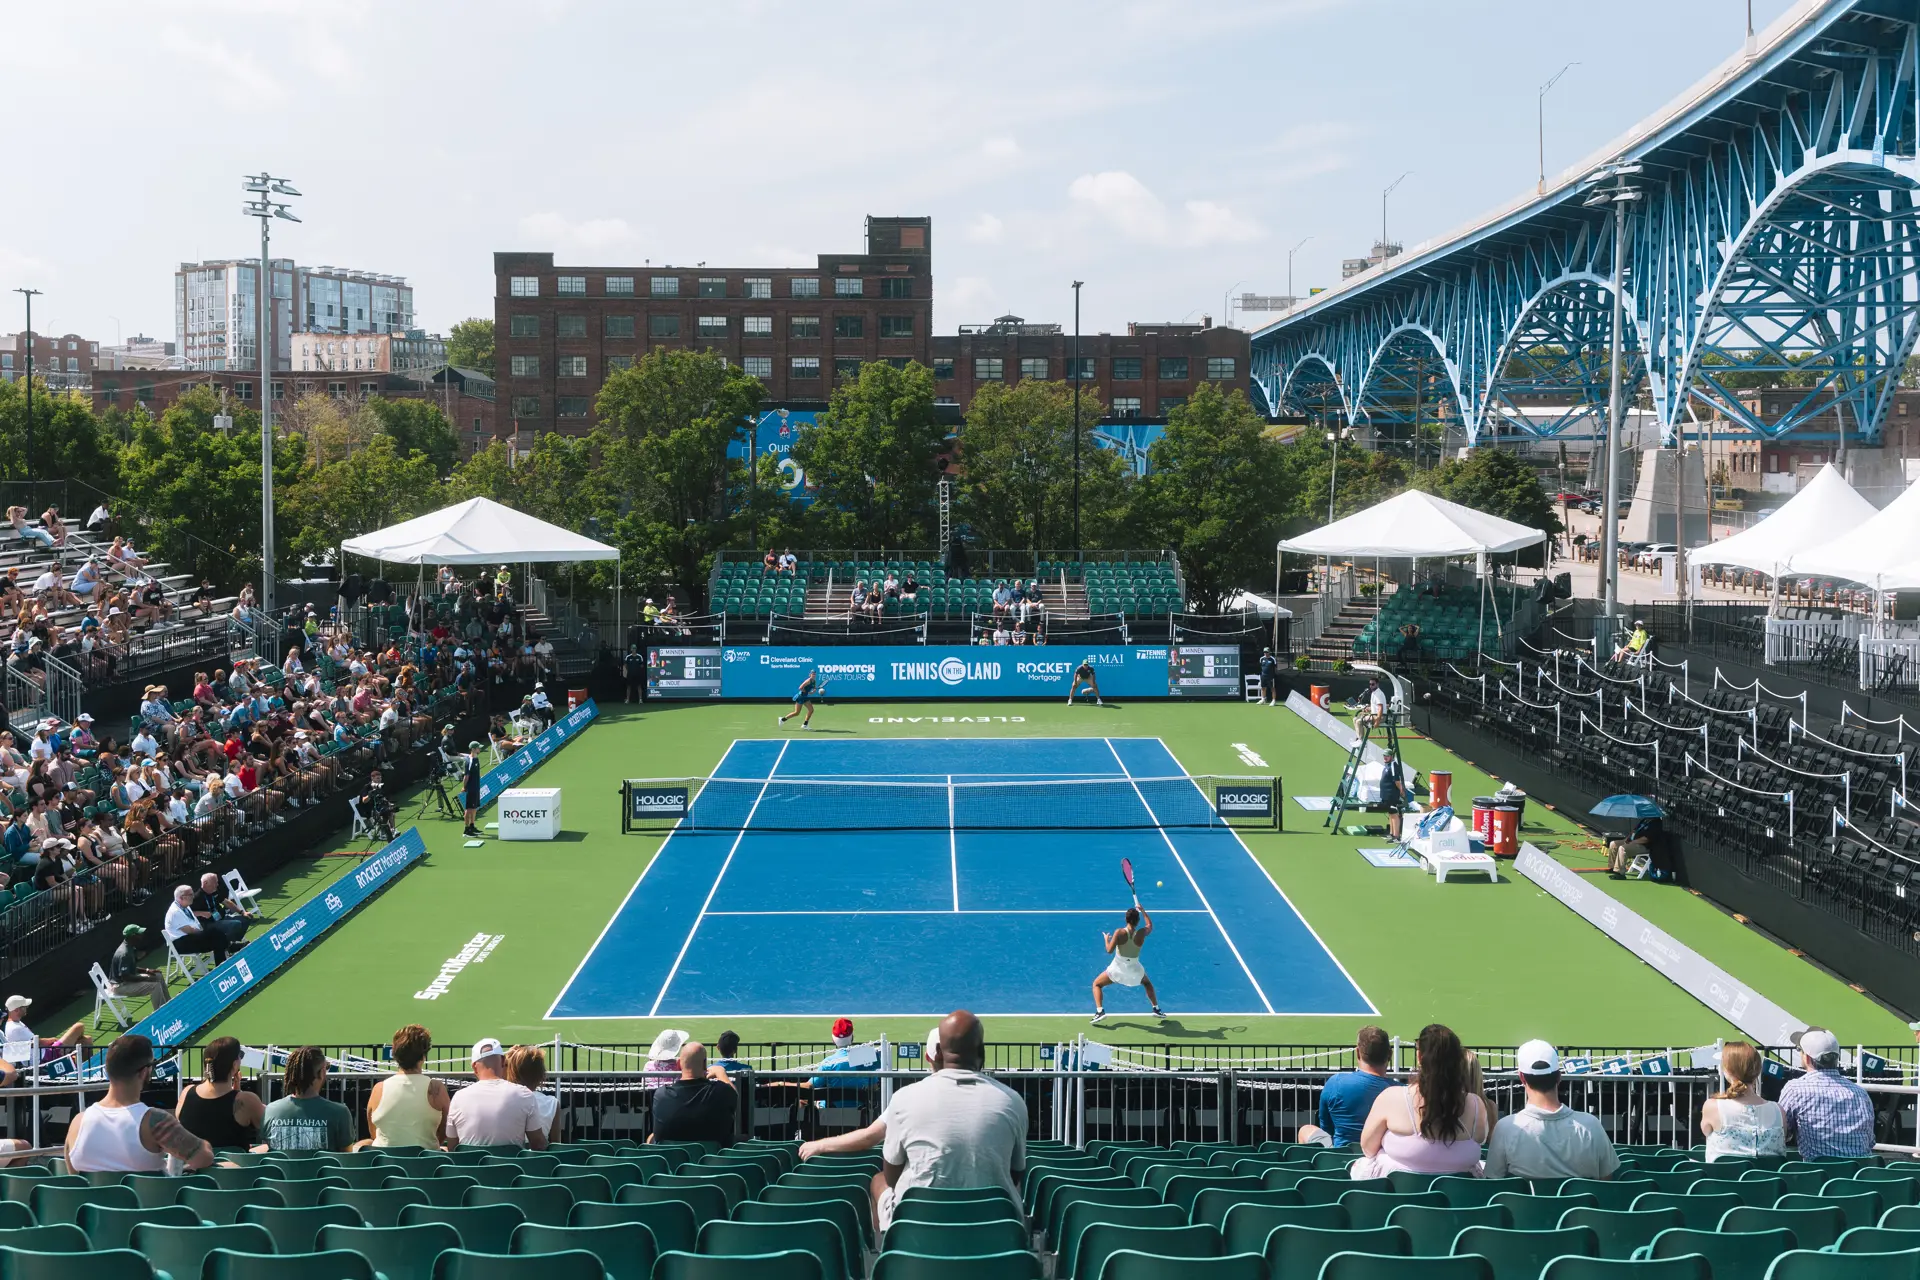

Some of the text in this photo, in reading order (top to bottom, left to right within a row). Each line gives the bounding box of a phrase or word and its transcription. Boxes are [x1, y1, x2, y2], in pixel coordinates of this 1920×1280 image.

[1099, 653, 1124, 664] MAI
[817, 664, 876, 673] TOPNOTCH
[890, 662, 1001, 680] TENNIS IN THE LAND
[1016, 662, 1073, 674] ROCKET
[817, 673, 866, 681] TENNIS TOURS
[1027, 674, 1062, 682] Mortgage
[636, 795, 684, 805] HOLOGIC
[1220, 793, 1268, 803] HOLOGIC
[503, 809, 548, 819] ROCKET
[355, 844, 409, 889] ROCKET Mortgage
[1523, 852, 1583, 904] ROCKET Mortgage
[218, 974, 238, 993] Ohio
[1709, 983, 1730, 1003] Ohio
[151, 1018, 183, 1046] Wayside
[271, 1118, 328, 1127] NOAH KAHAN
